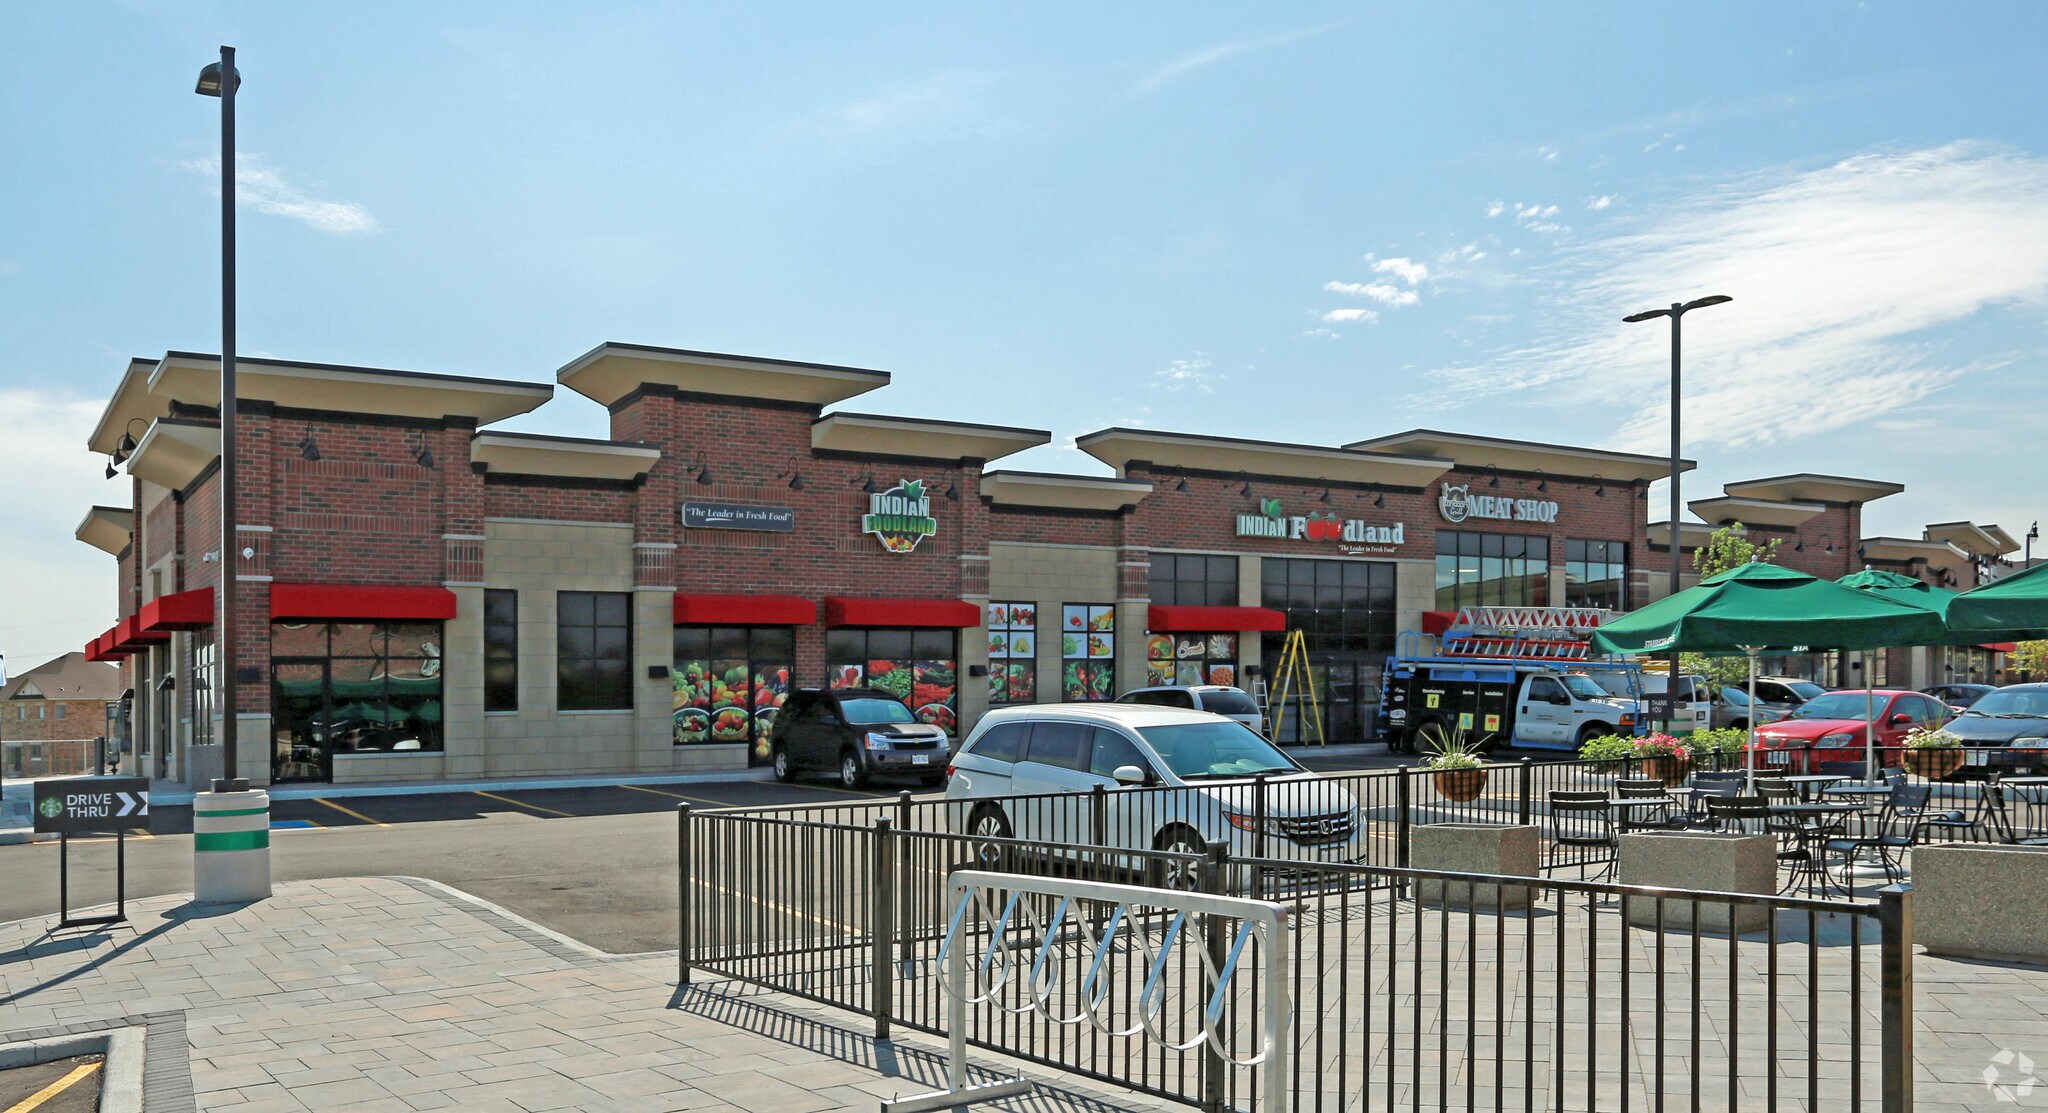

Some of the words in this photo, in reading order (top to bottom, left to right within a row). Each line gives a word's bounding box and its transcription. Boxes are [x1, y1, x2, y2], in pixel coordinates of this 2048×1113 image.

[707, 508, 734, 519] Leader
[736, 510, 744, 519] in
[746, 511, 767, 520] Fresh
[874, 495, 928, 517] INDIAN
[1469, 494, 1514, 519] MEAT
[1516, 499, 1558, 523] SHOP
[866, 515, 936, 535] FOODLAND
[1238, 514, 1287, 537] INDIAN
[66, 793, 112, 806] DRIVE
[67, 806, 109, 818] THRU
